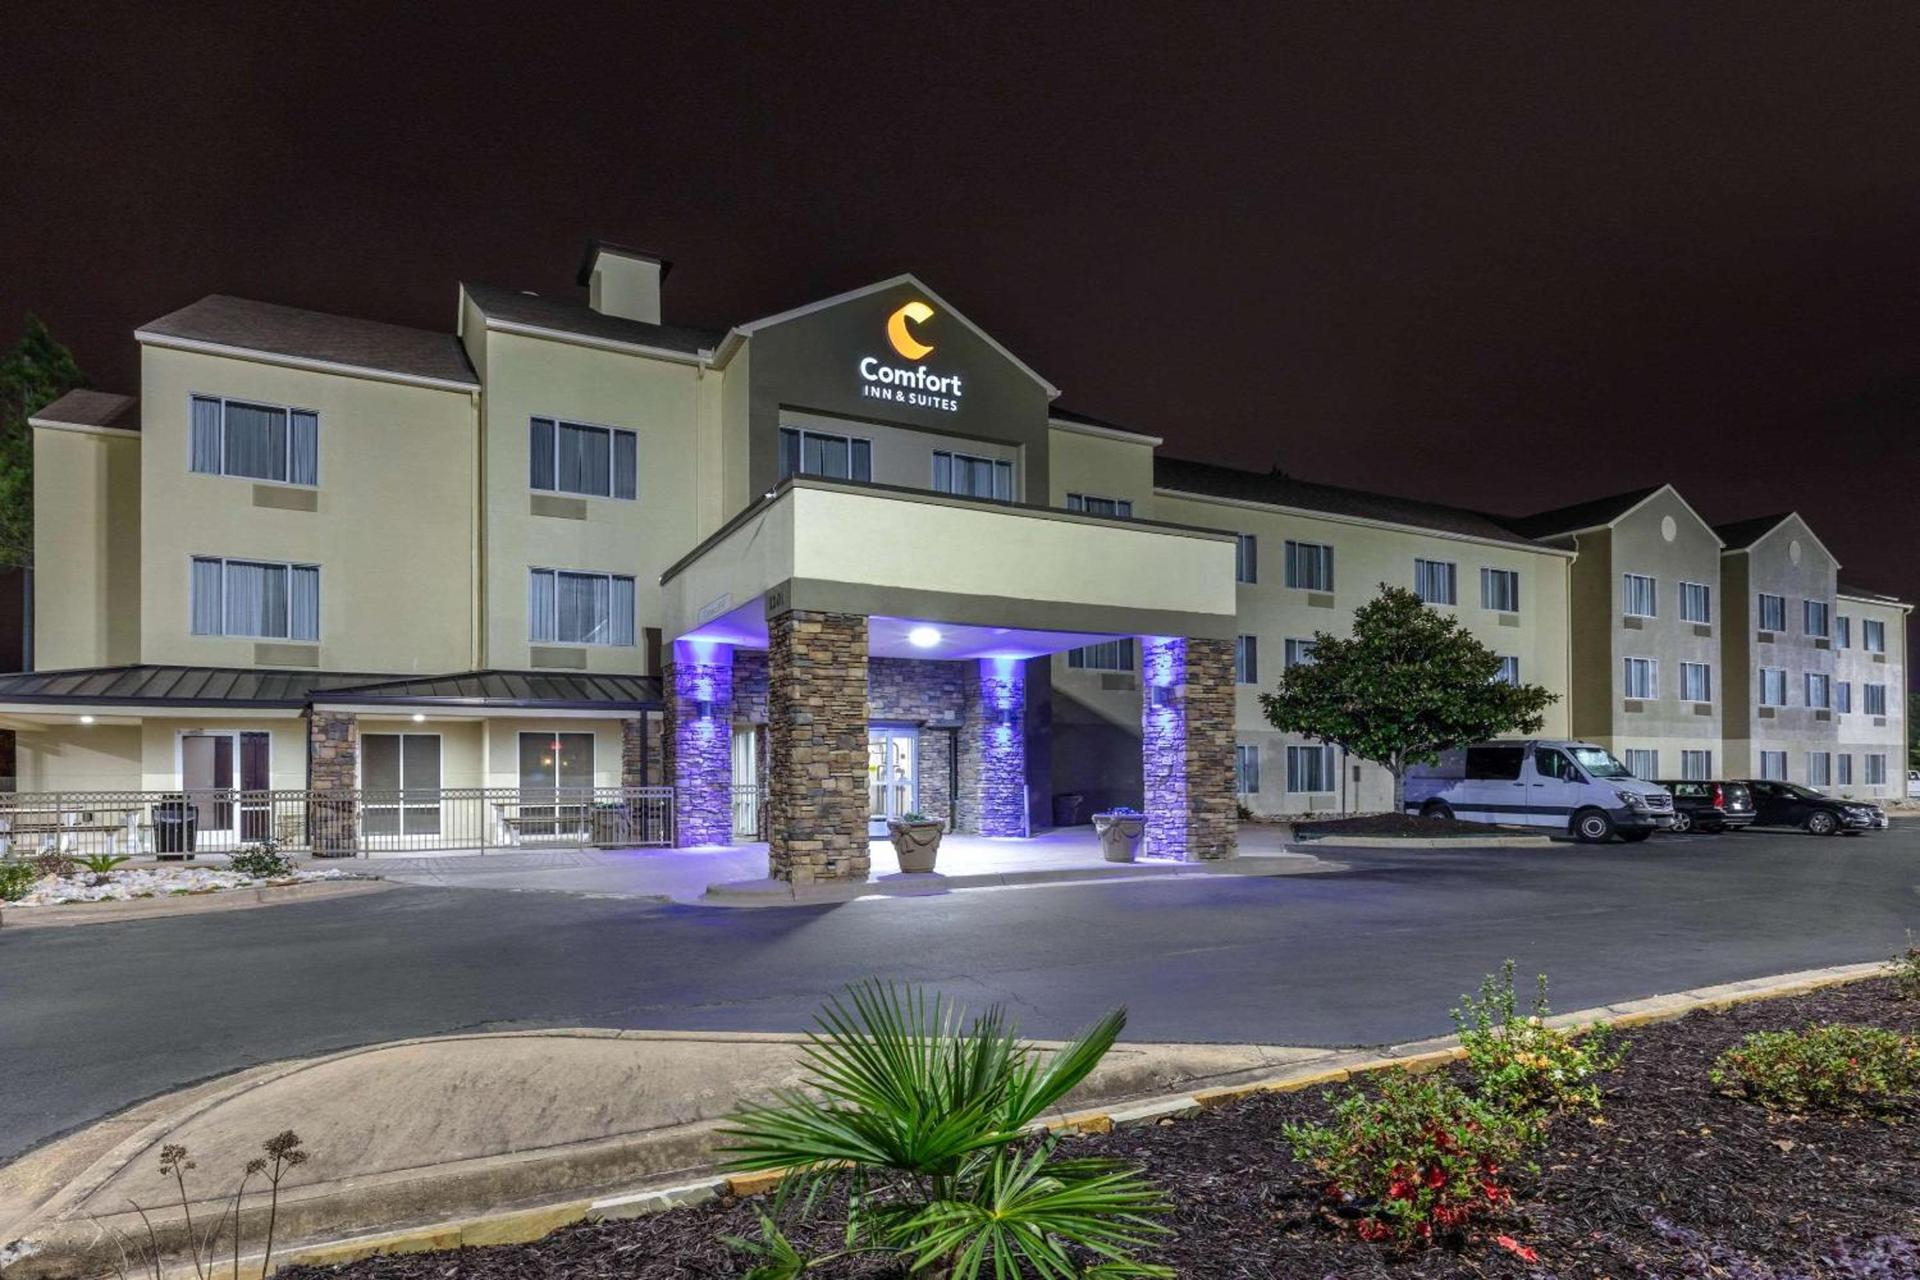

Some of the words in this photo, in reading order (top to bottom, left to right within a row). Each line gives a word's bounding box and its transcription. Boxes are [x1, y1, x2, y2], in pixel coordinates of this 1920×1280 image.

[860, 357, 962, 396] Comfort
[864, 385, 892, 400] INN
[896, 391, 905, 402] &
[908, 393, 957, 411] SUITES
